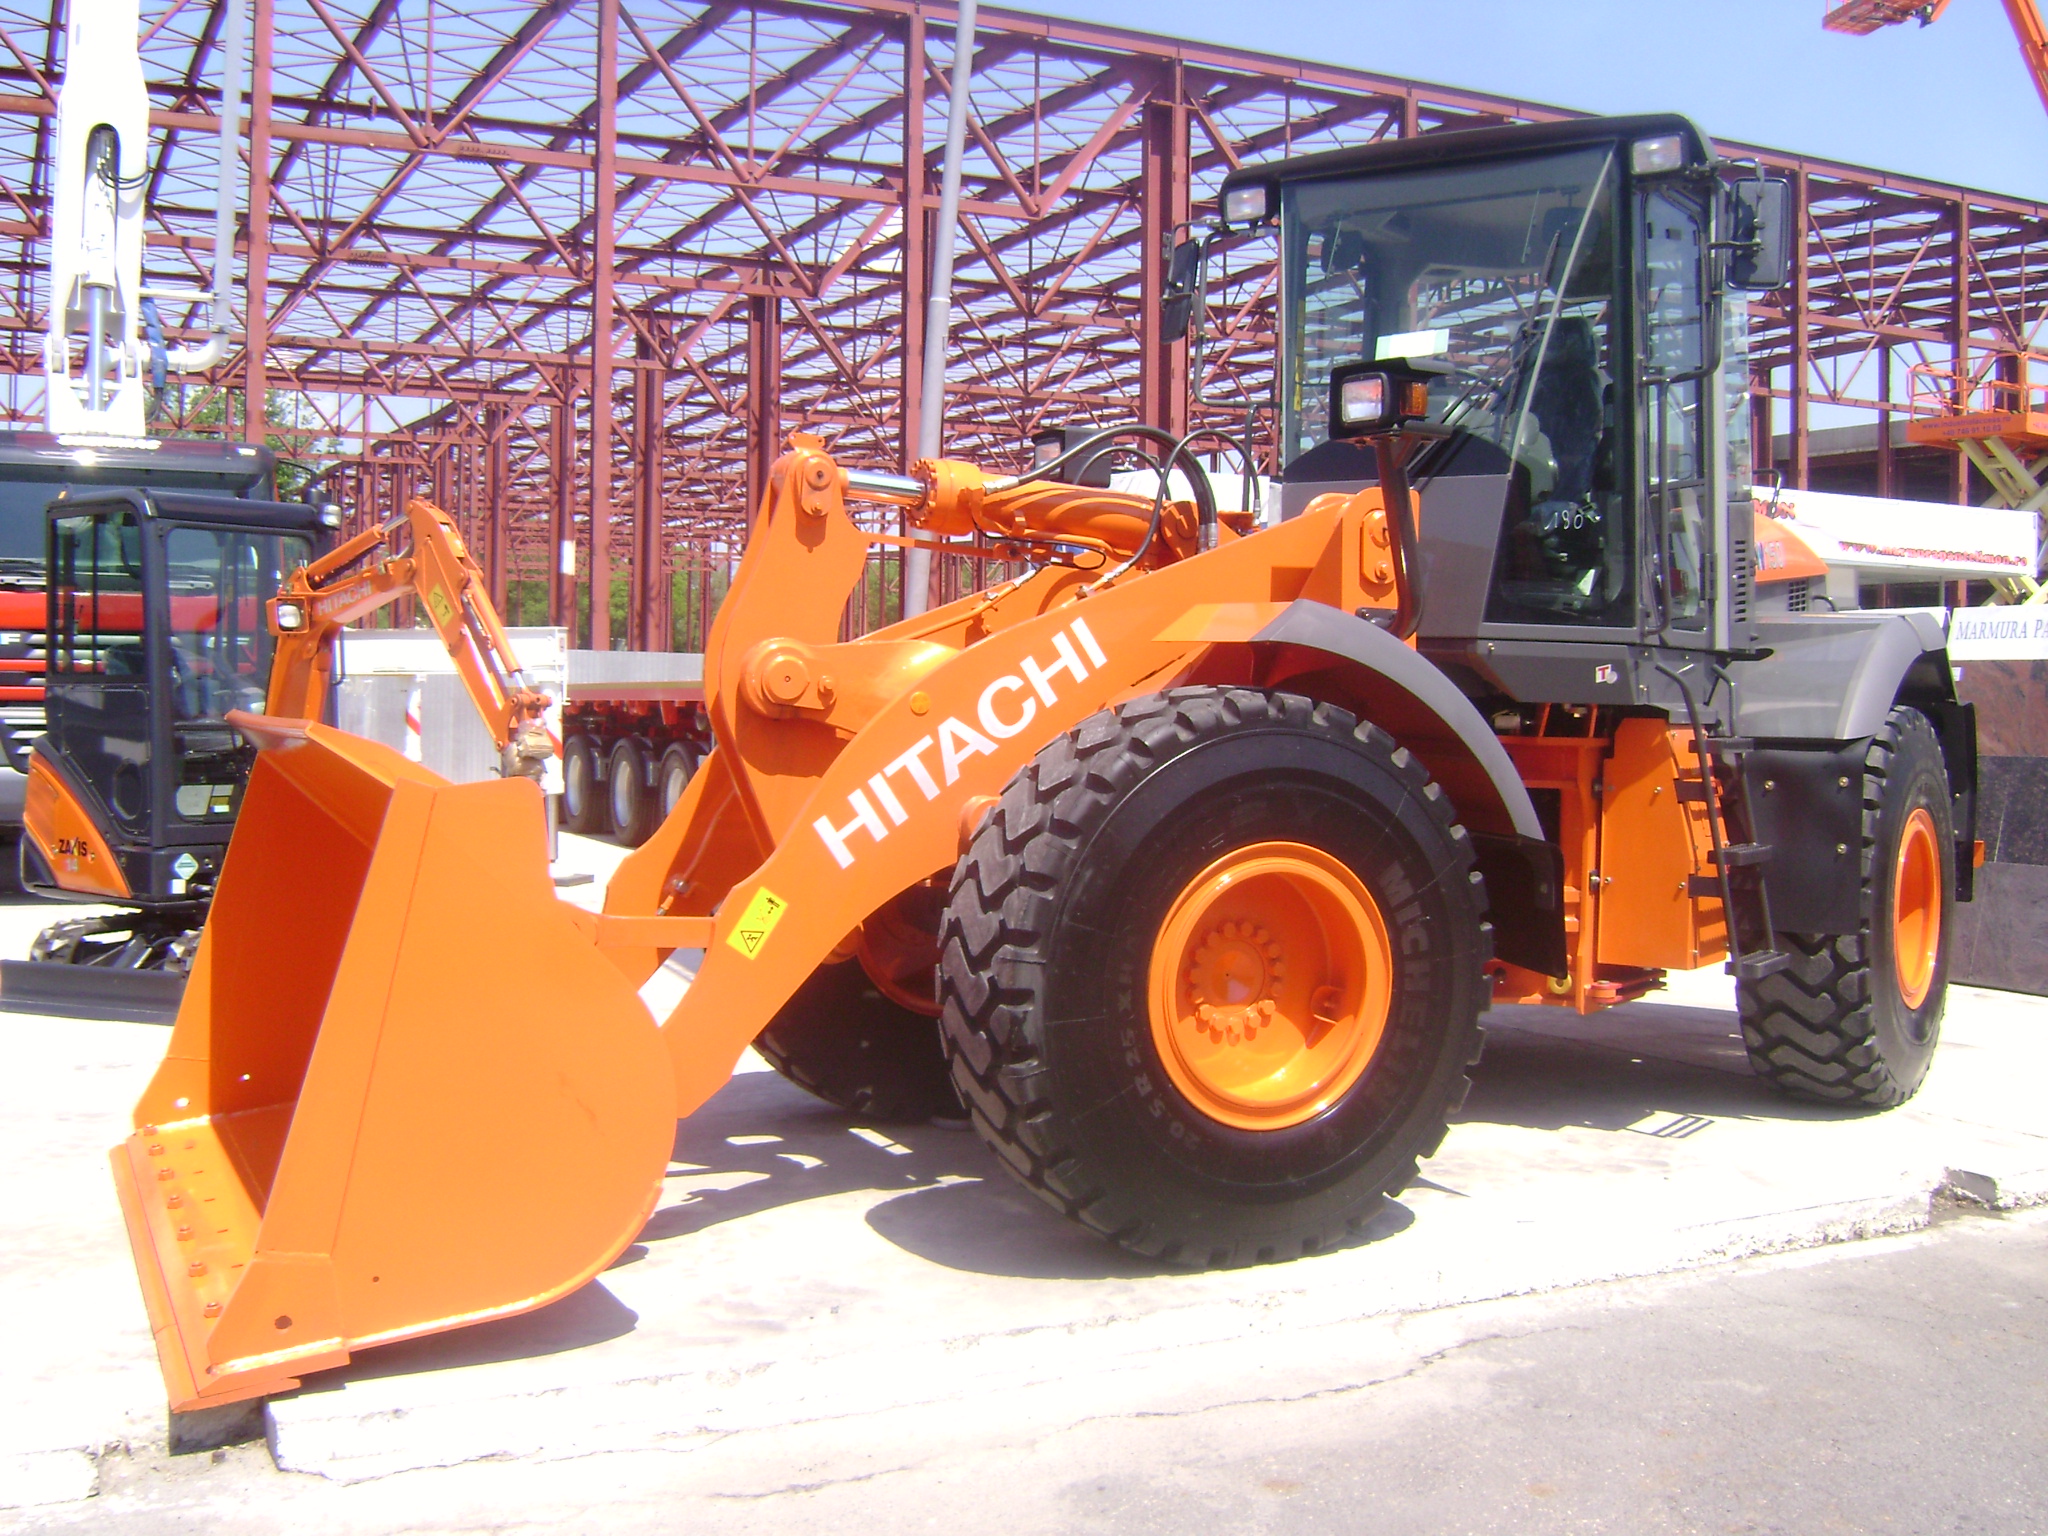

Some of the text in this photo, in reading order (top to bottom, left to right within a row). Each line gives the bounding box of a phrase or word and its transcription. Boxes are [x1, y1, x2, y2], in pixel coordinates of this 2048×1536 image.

[318, 580, 372, 616] HITACHI
[1956, 620, 2028, 640] MARMURA
[812, 616, 1109, 870] HITACHI
[59, 836, 88, 857] ZAXIS
